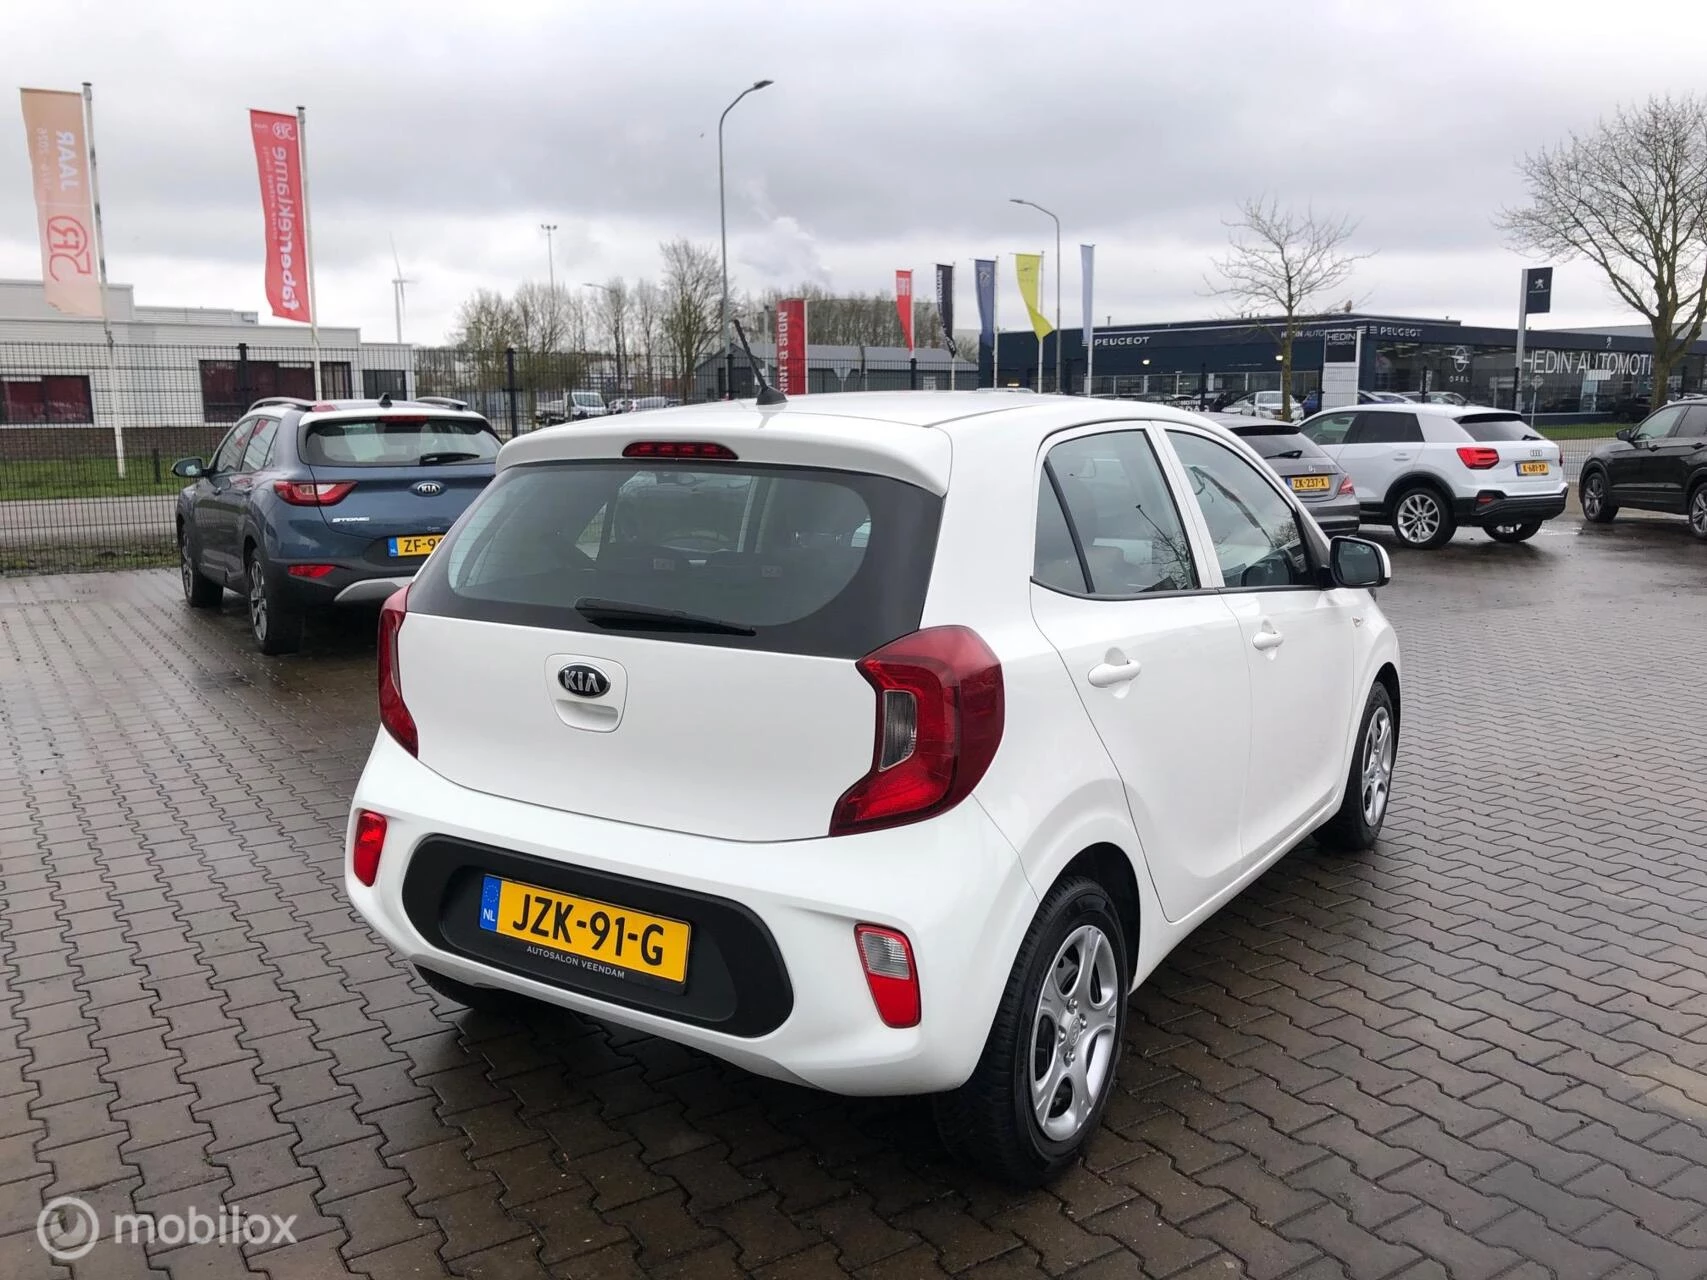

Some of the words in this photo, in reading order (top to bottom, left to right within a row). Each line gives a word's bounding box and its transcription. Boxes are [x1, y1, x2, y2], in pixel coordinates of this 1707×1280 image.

[778, 311, 788, 347] SIGN
[1327, 333, 1356, 341] HEDIN
[1380, 326, 1423, 337] PEUGEOT
[1094, 336, 1150, 346] PEUGEOT
[1576, 352, 1653, 376] AUTOMOTI
[779, 366, 789, 393] RINT
[1449, 375, 1470, 383] OPEL
[404, 538, 443, 553] ZF-9
[564, 669, 600, 693] KIA
[482, 908, 496, 922] NL
[512, 893, 665, 967] JZK-91-G
[526, 945, 579, 967] AUTOSALON
[581, 959, 625, 980] VEENDAM
